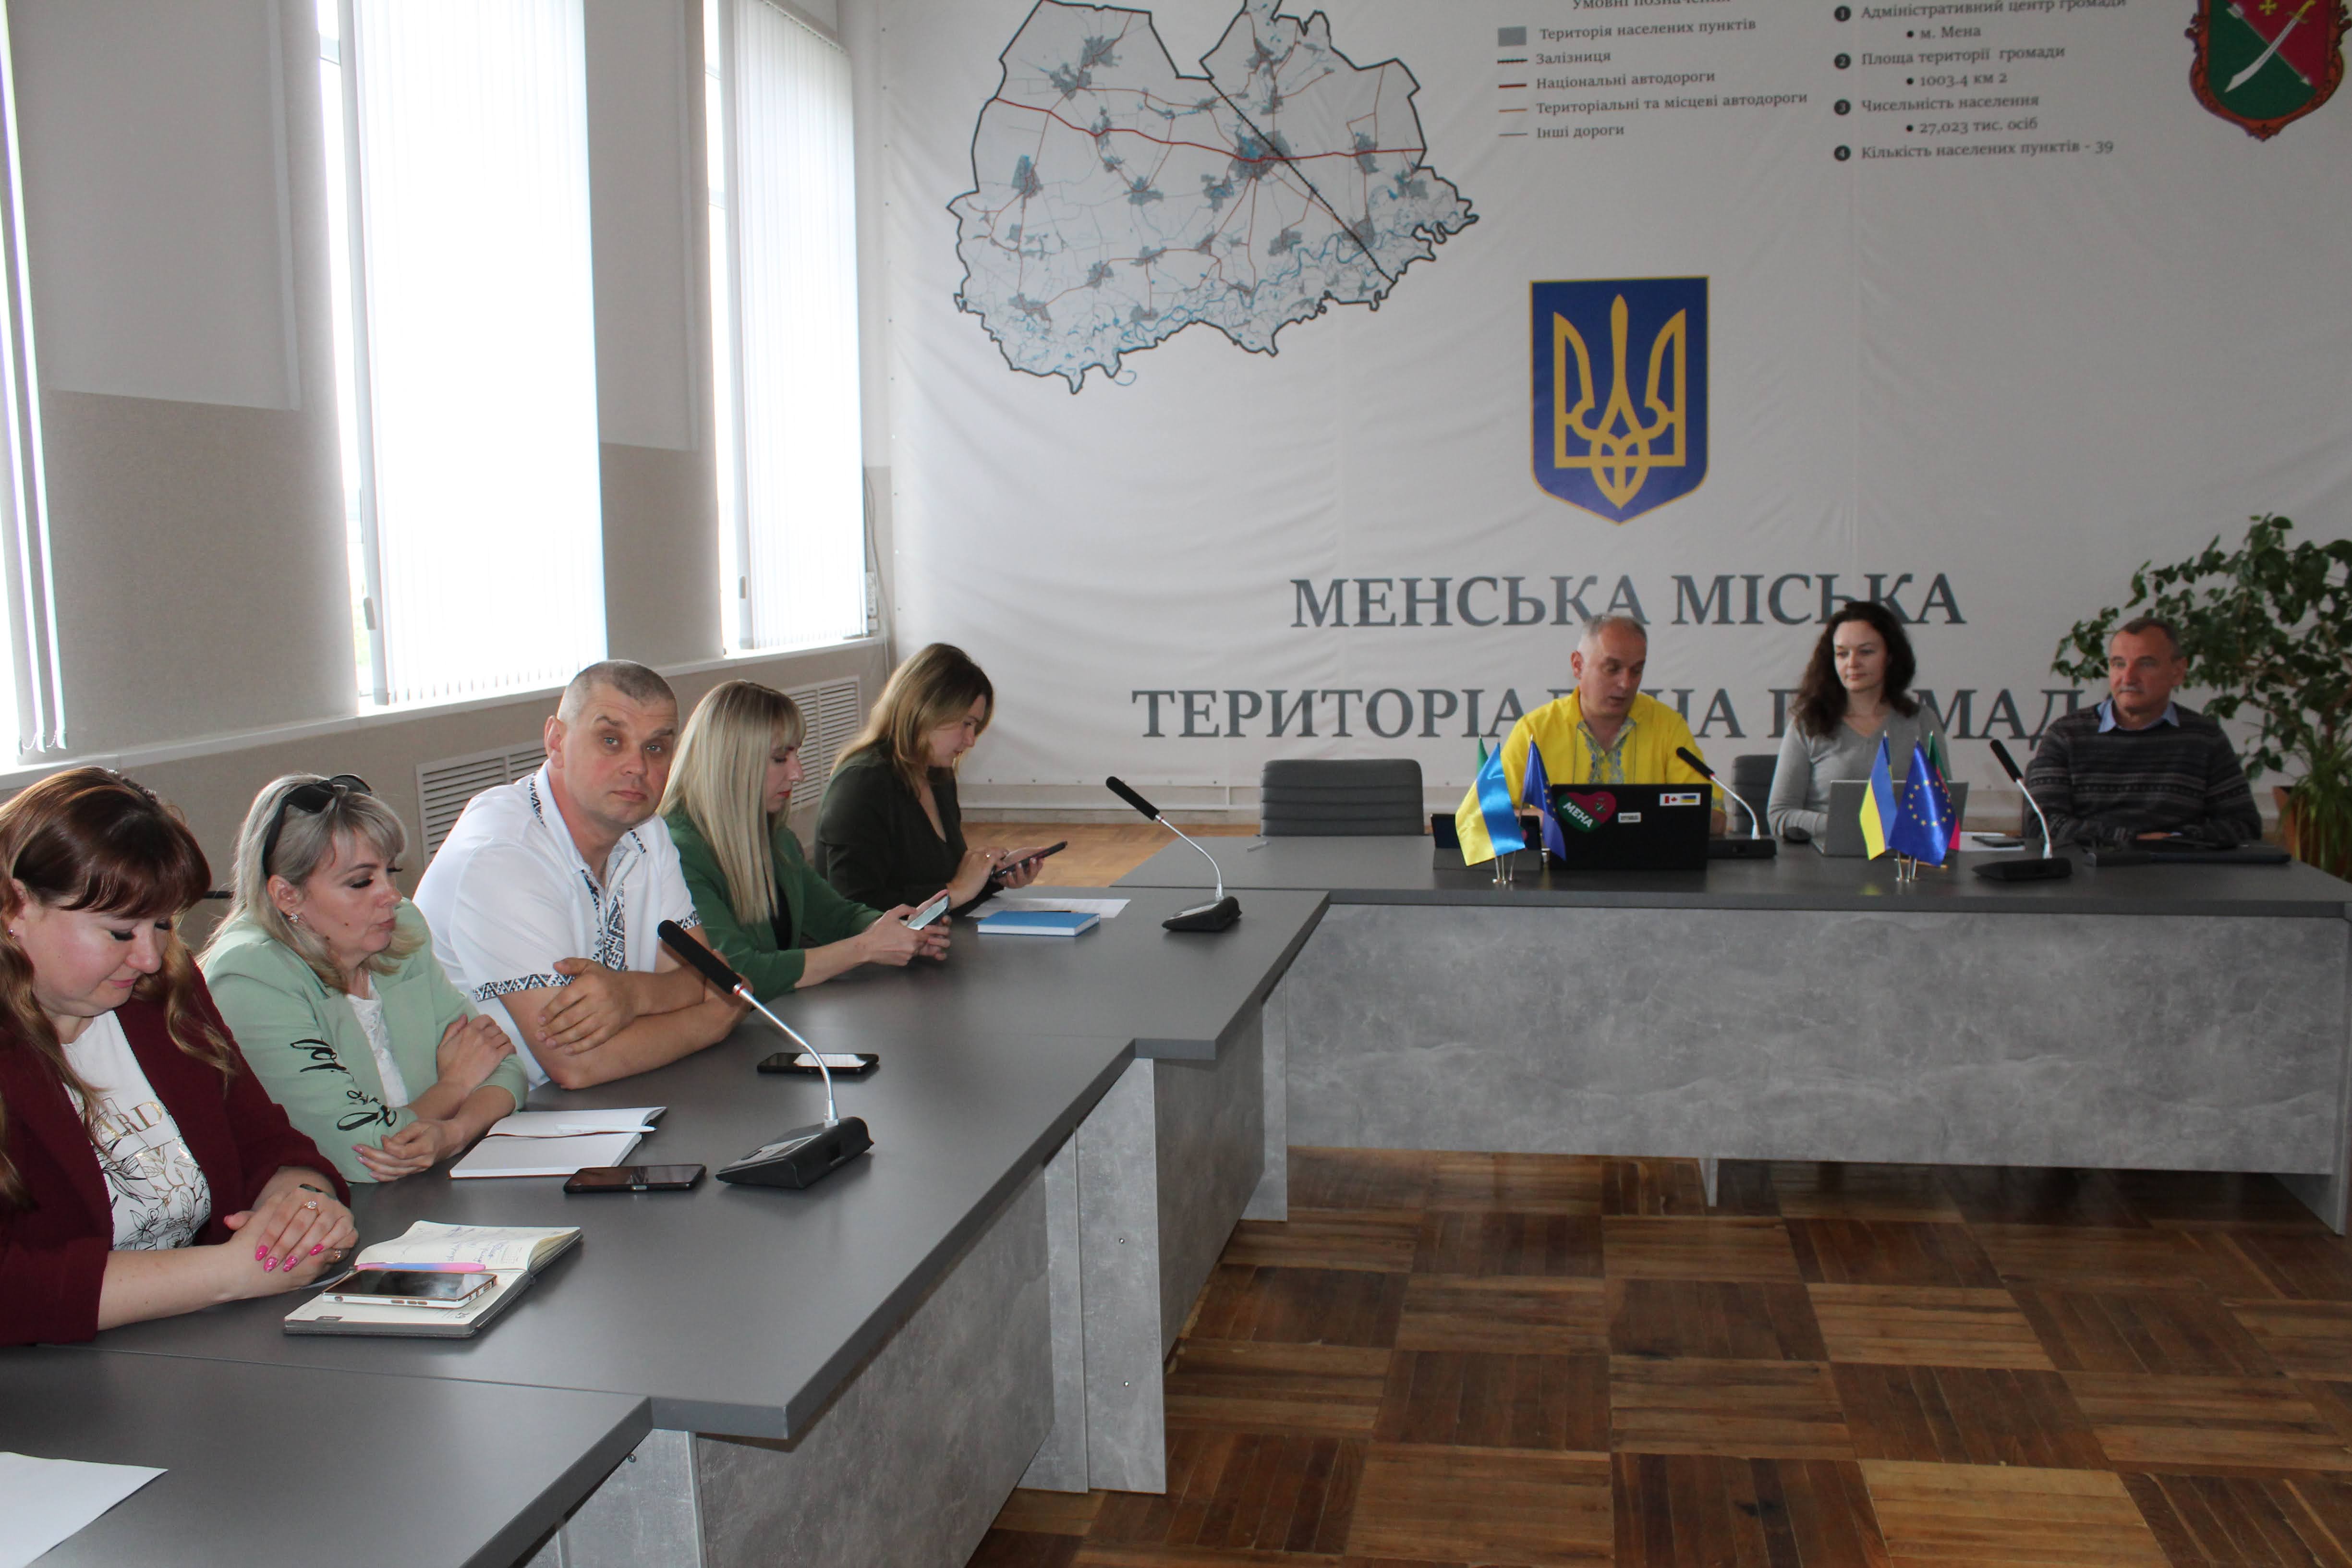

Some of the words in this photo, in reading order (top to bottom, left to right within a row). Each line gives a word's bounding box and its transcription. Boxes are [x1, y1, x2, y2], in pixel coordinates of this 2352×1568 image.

[1861, 1, 2003, 19] Адміністративний
[2009, 0, 2054, 13] центр
[2060, 0, 2126, 12] громади
[1540, 25, 1612, 42] Територія
[1617, 24, 1694, 36] населених
[1699, 19, 1756, 35] пунктів
[1921, 30, 1935, 39] м.
[1941, 25, 1981, 38] Мена
[1537, 52, 1611, 64] Залізниця
[1862, 53, 1914, 65] Площа
[1918, 49, 1990, 65] території
[2000, 48, 2065, 62] громади
[1537, 74, 1626, 89] Національні
[1631, 73, 1715, 86] автодороги
[1974, 74, 1993, 84] км
[1999, 73, 2007, 83] 2
[1536, 98, 1639, 116] Територіальні
[1644, 100, 1660, 109] та
[1665, 95, 1718, 109] місцеві
[1722, 94, 1807, 107] автодороги
[1861, 97, 1954, 112] Чисельність
[1959, 96, 2039, 109] населення
[1537, 126, 1568, 138] Інші
[1573, 127, 1624, 139] дороги
[1973, 122, 2002, 131] тис.
[2007, 117, 2038, 130] осіб
[1862, 146, 1932, 159] Кількість
[1936, 145, 2015, 156] населених
[2021, 140, 2080, 157] пунктів
[2095, 141, 2114, 154] 39
[1290, 574, 1651, 627] МЕНСЬКА
[1671, 572, 1967, 625] МІСЬКА
[1131, 687, 1747, 738] ТЕРИТОРІАА
[1563, 801, 1594, 828] МЕНА
